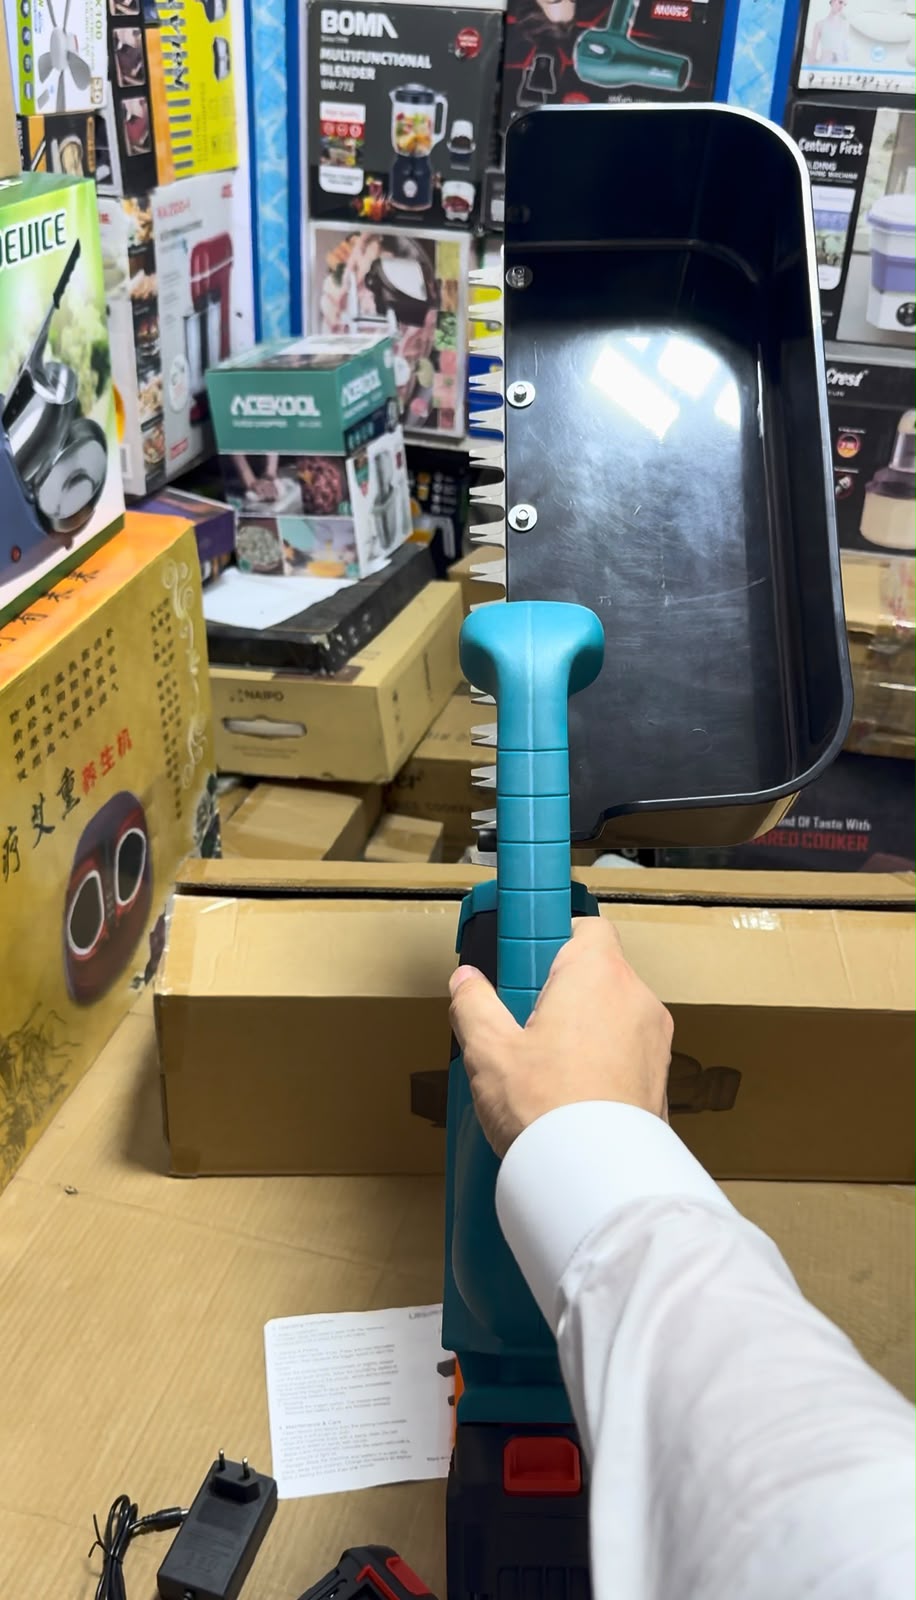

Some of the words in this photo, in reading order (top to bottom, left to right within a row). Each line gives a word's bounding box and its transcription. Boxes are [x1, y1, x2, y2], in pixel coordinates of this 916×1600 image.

[320, 8, 399, 39] BOMA
[319, 47, 432, 69] MULTIFUNCTIONAL
[319, 62, 375, 80] BLENDER
[799, 137, 838, 157] Century
[839, 140, 863, 156] First
[0, 212, 66, 267] EVICE
[231, 394, 321, 416] ACEKOOL
[813, 816, 844, 831] Taste
[802, 832, 868, 852] COOKER
